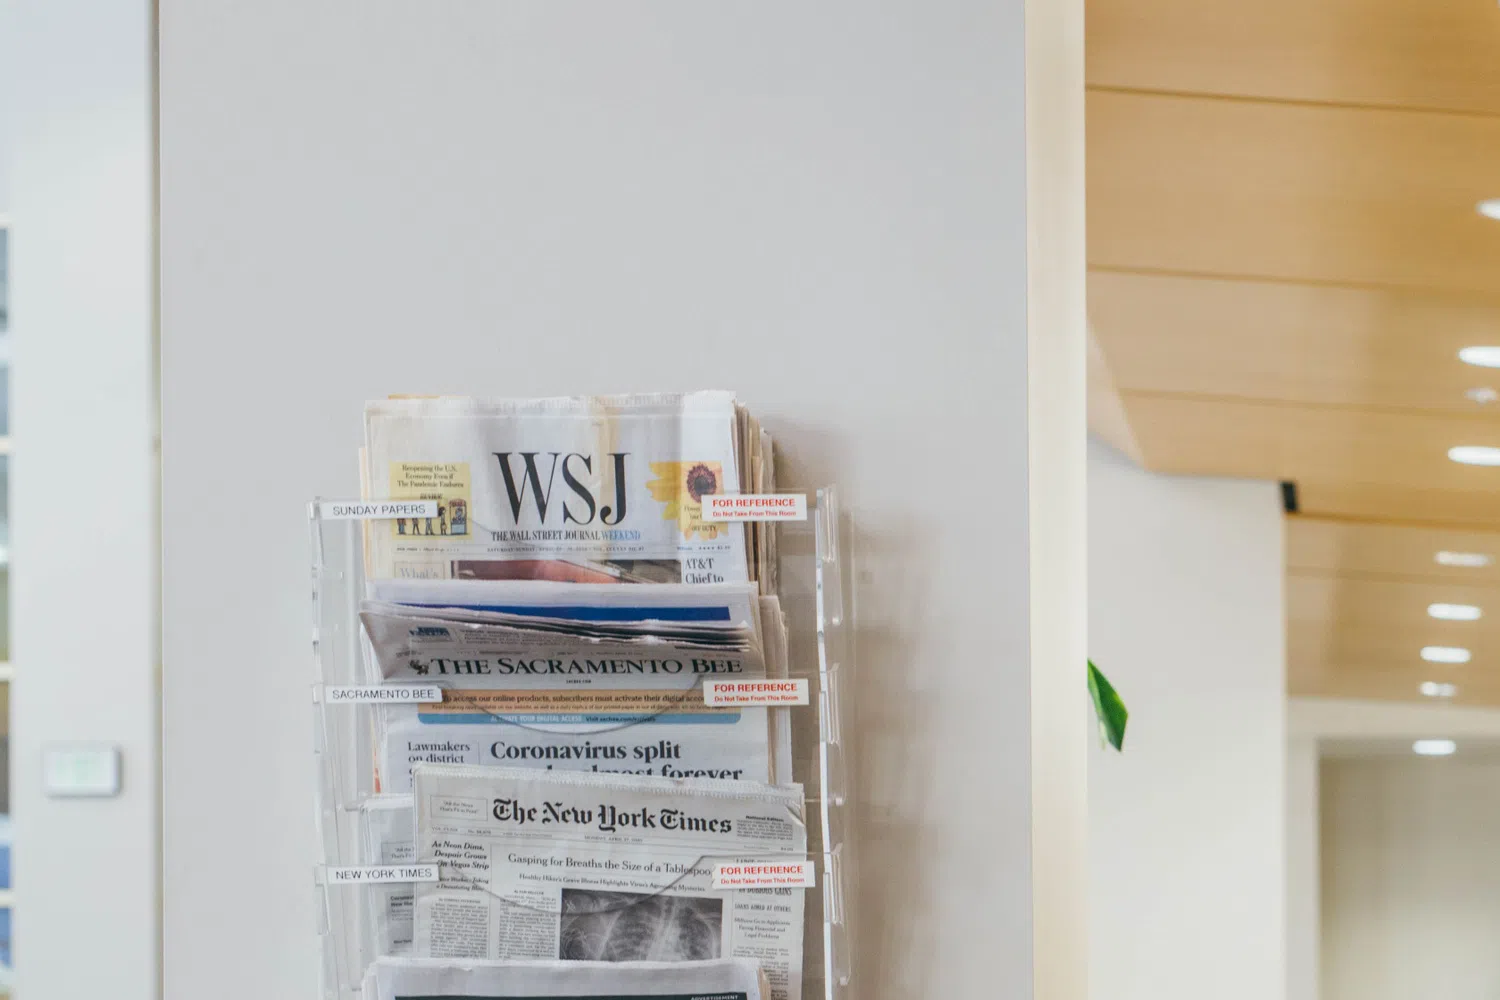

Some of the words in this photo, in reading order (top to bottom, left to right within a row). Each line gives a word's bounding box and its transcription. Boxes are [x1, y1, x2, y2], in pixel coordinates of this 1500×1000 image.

[492, 452, 631, 525] WSJ
[712, 499, 733, 508] FOR
[736, 498, 796, 507] REFERENCE
[333, 505, 377, 516] SUNDAY
[381, 504, 426, 515] PAPERS
[491, 531, 510, 541] THE
[510, 530, 531, 541] WALL
[532, 530, 563, 541] STREET
[563, 530, 600, 541] JOURNAL
[601, 530, 641, 541] WEEKEND
[685, 558, 715, 570] AT&T
[685, 572, 712, 584] Chief
[713, 574, 724, 583] to
[431, 658, 491, 675] THE
[498, 658, 682, 675] SACRAMENTO
[692, 658, 743, 674] BEE
[714, 684, 735, 692] FOR
[737, 683, 798, 692] REFERENCE
[332, 689, 410, 700] SACRAMENTO
[412, 689, 435, 699] BEE
[408, 741, 470, 751] Lawmakers
[491, 741, 627, 760] Coronavirus
[633, 740, 681, 763] split
[426, 753, 464, 763] district
[493, 798, 538, 824] The
[542, 801, 593, 824] New
[597, 804, 656, 833] York
[659, 807, 732, 834] Times
[443, 841, 462, 849] Neon
[434, 850, 462, 859] Despair
[464, 852, 487, 860] Grows
[450, 860, 471, 869] Vegas
[471, 861, 490, 870] Strip
[508, 853, 548, 867] Gasping
[550, 856, 563, 867] for
[566, 857, 602, 868] Breaths
[604, 859, 620, 870] the
[622, 860, 642, 870] Size
[643, 862, 654, 872] of
[663, 862, 712, 877] Tablespoo
[720, 867, 742, 875] FOR
[744, 866, 804, 875] REFERENCE
[335, 870, 362, 880] NEW
[365, 870, 395, 879] YORK
[399, 868, 432, 878] TIMES
